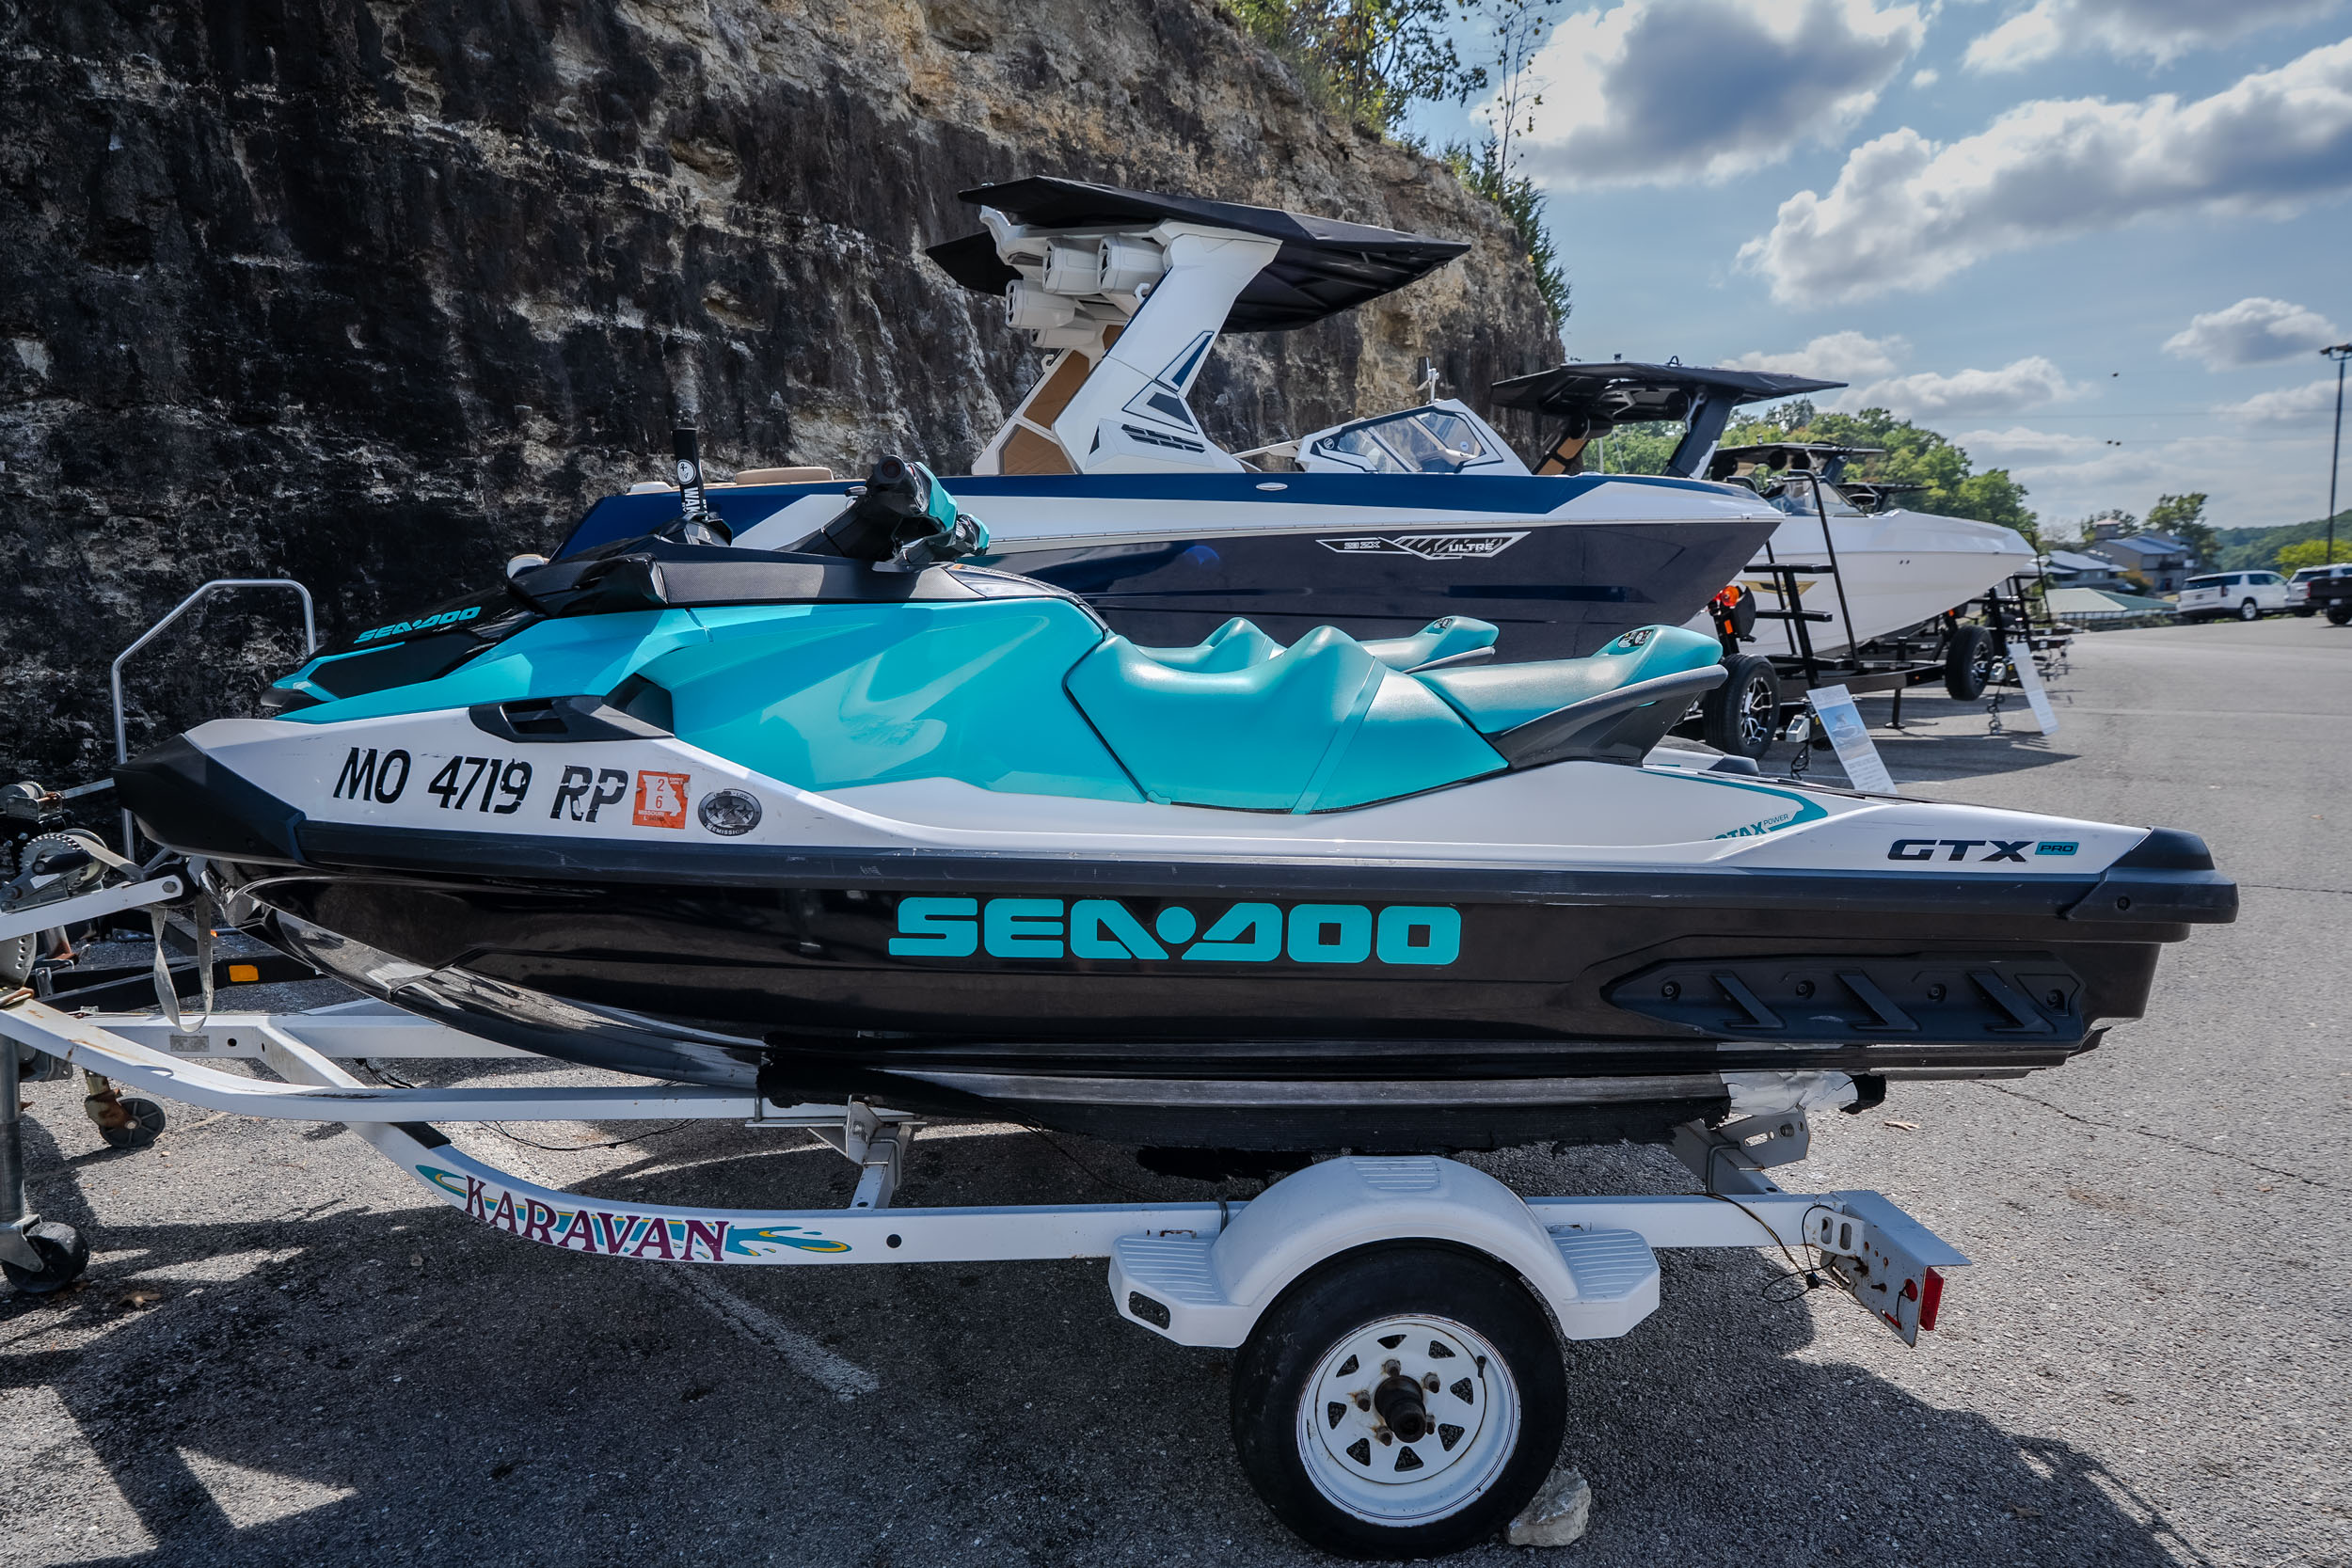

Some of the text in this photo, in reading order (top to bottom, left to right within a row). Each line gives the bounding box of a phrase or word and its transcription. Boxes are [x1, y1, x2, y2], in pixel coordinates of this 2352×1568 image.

[1447, 542, 1496, 553] ULTRE
[332, 747, 628, 823] MO 4719 RP
[657, 779, 665, 792] 2
[655, 795, 663, 809] 6
[1763, 814, 1789, 826] POWER
[1887, 839, 2074, 863] GTX PRO
[465, 1175, 730, 1262] KARAVAN
